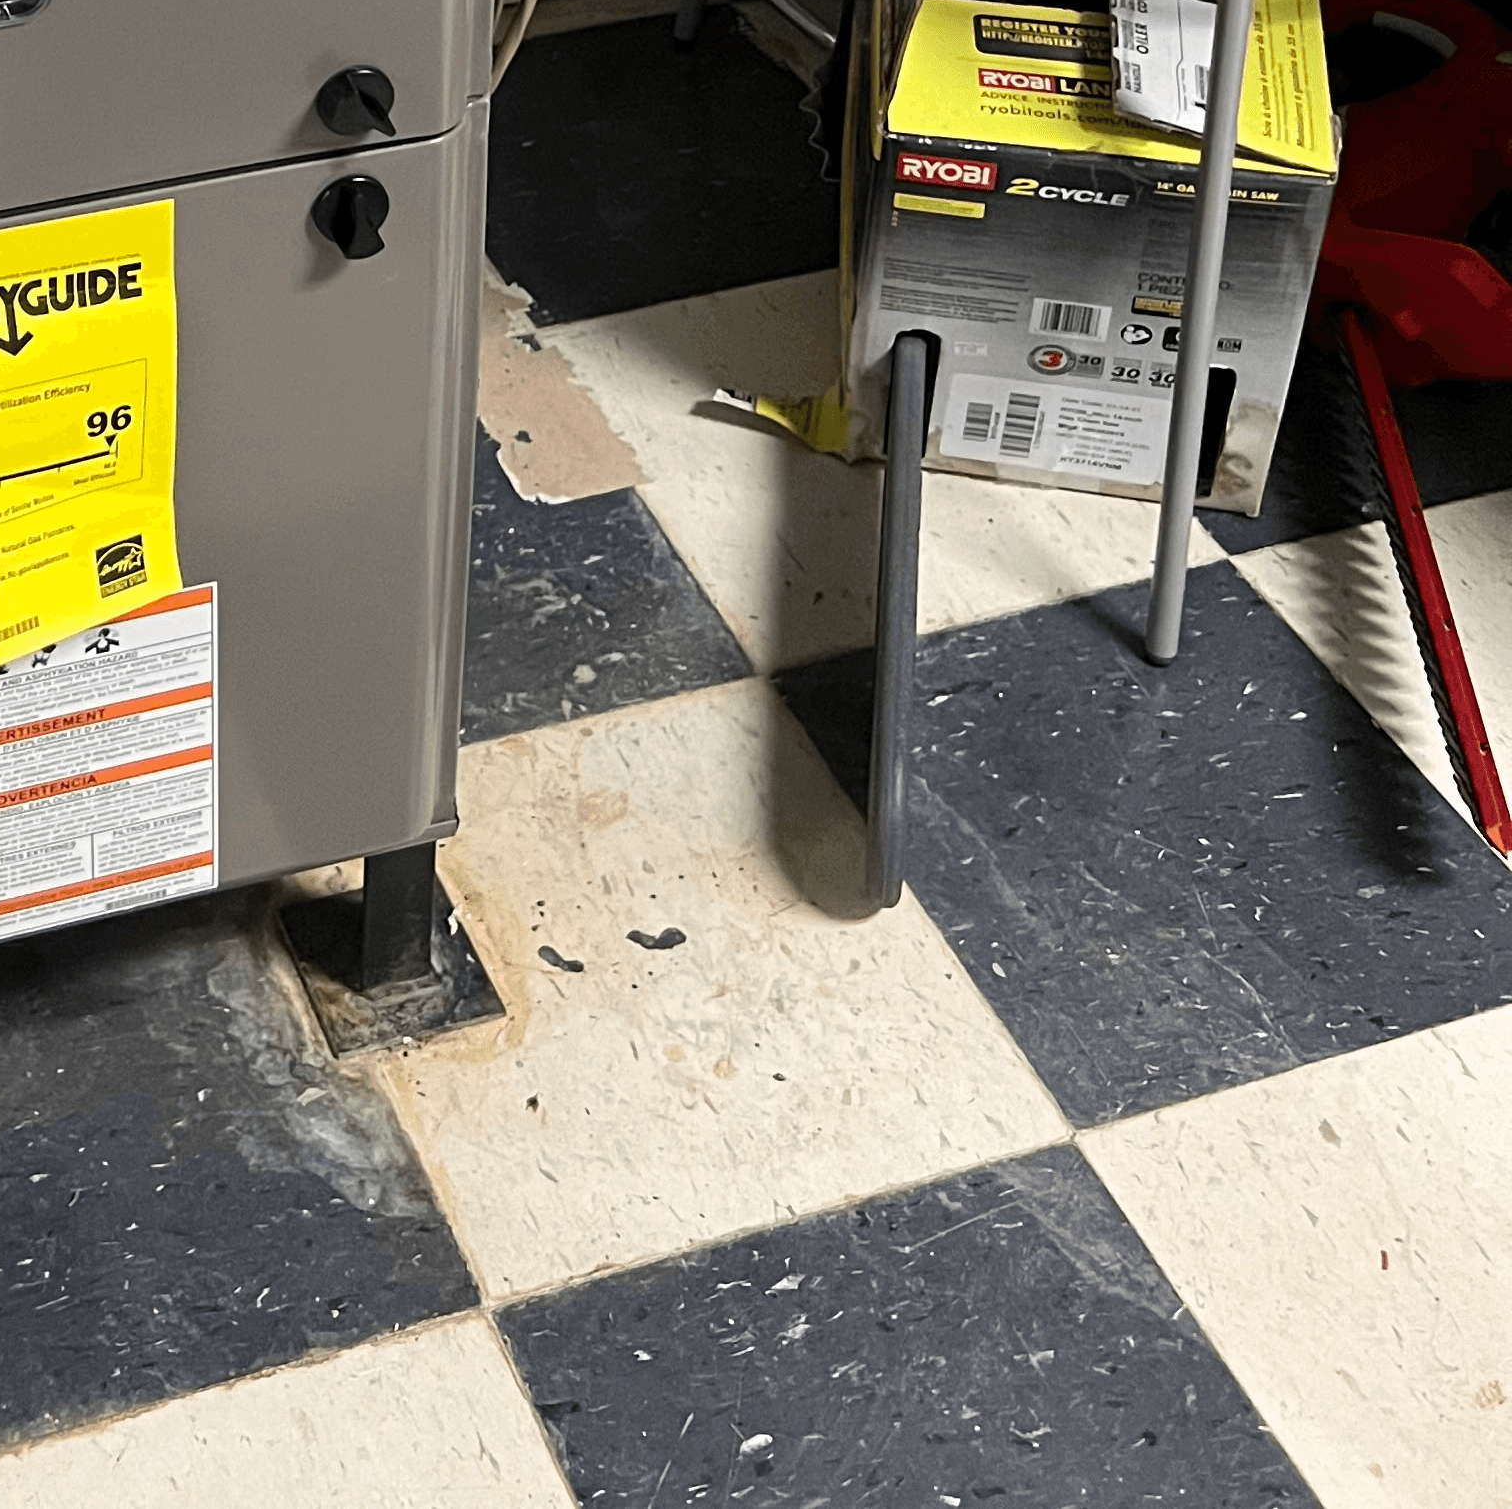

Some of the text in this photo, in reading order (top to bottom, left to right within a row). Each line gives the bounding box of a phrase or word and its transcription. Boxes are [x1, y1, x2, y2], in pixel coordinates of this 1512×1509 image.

[980, 18, 1060, 36] REGISTER
[1134, 23, 1150, 54] OILER
[980, 71, 1111, 98] RYOBI LAN
[980, 91, 1029, 103] ADVICE
[901, 158, 991, 185] RYOBI
[1176, 184, 1196, 193] GA
[1077, 355, 1102, 366] 30
[1111, 366, 1141, 379] 30
[44, 382, 92, 400] Efficiency
[86, 404, 133, 437] 96
[1, 677, 23, 688] AND
[98, 651, 139, 666] HAZARD
